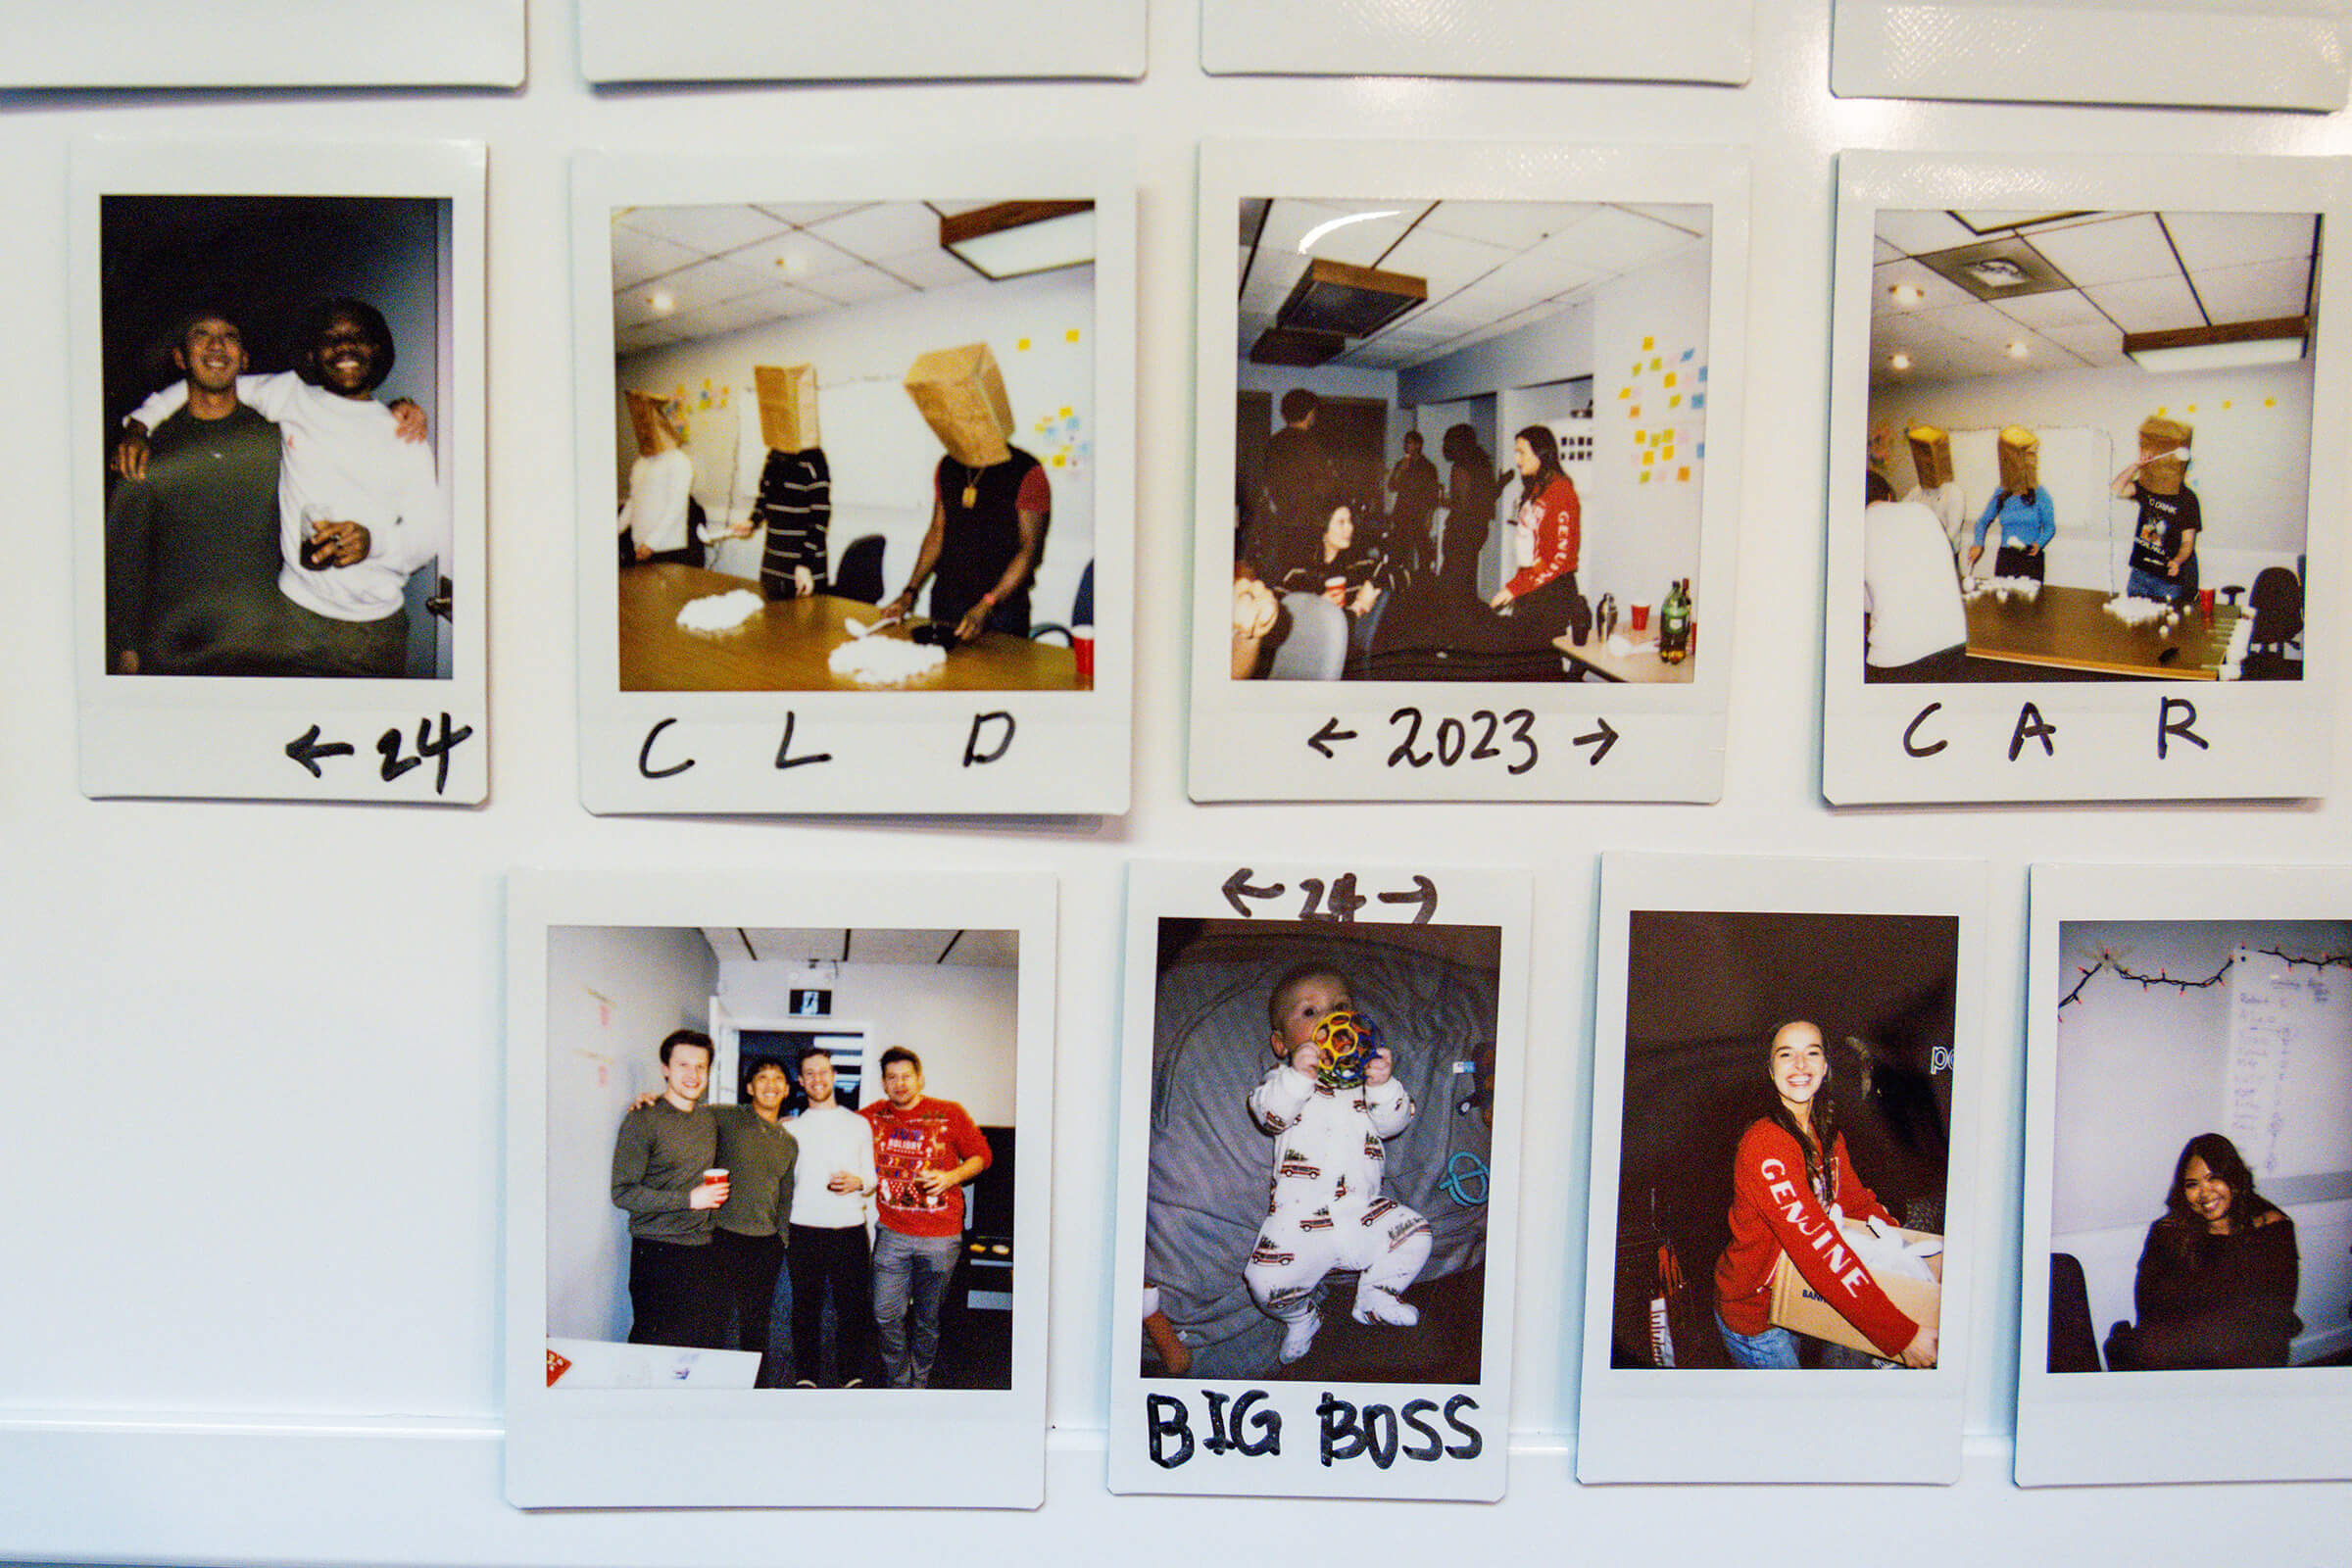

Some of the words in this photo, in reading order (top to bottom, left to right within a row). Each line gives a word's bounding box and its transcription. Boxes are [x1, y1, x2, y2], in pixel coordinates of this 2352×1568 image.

[375, 711, 472, 795] 24
[639, 718, 696, 778] C
[775, 710, 832, 769] L
[962, 711, 1015, 768] D
[1387, 707, 1539, 775] 2023
[1903, 702, 1948, 758] C
[2008, 702, 2057, 762] A
[2157, 696, 2209, 760] R
[1298, 872, 1369, 923] 24
[1761, 1158, 1870, 1298] GENUINE
[1146, 1389, 1283, 1470] BIG
[1315, 1392, 1483, 1470] BOSS
